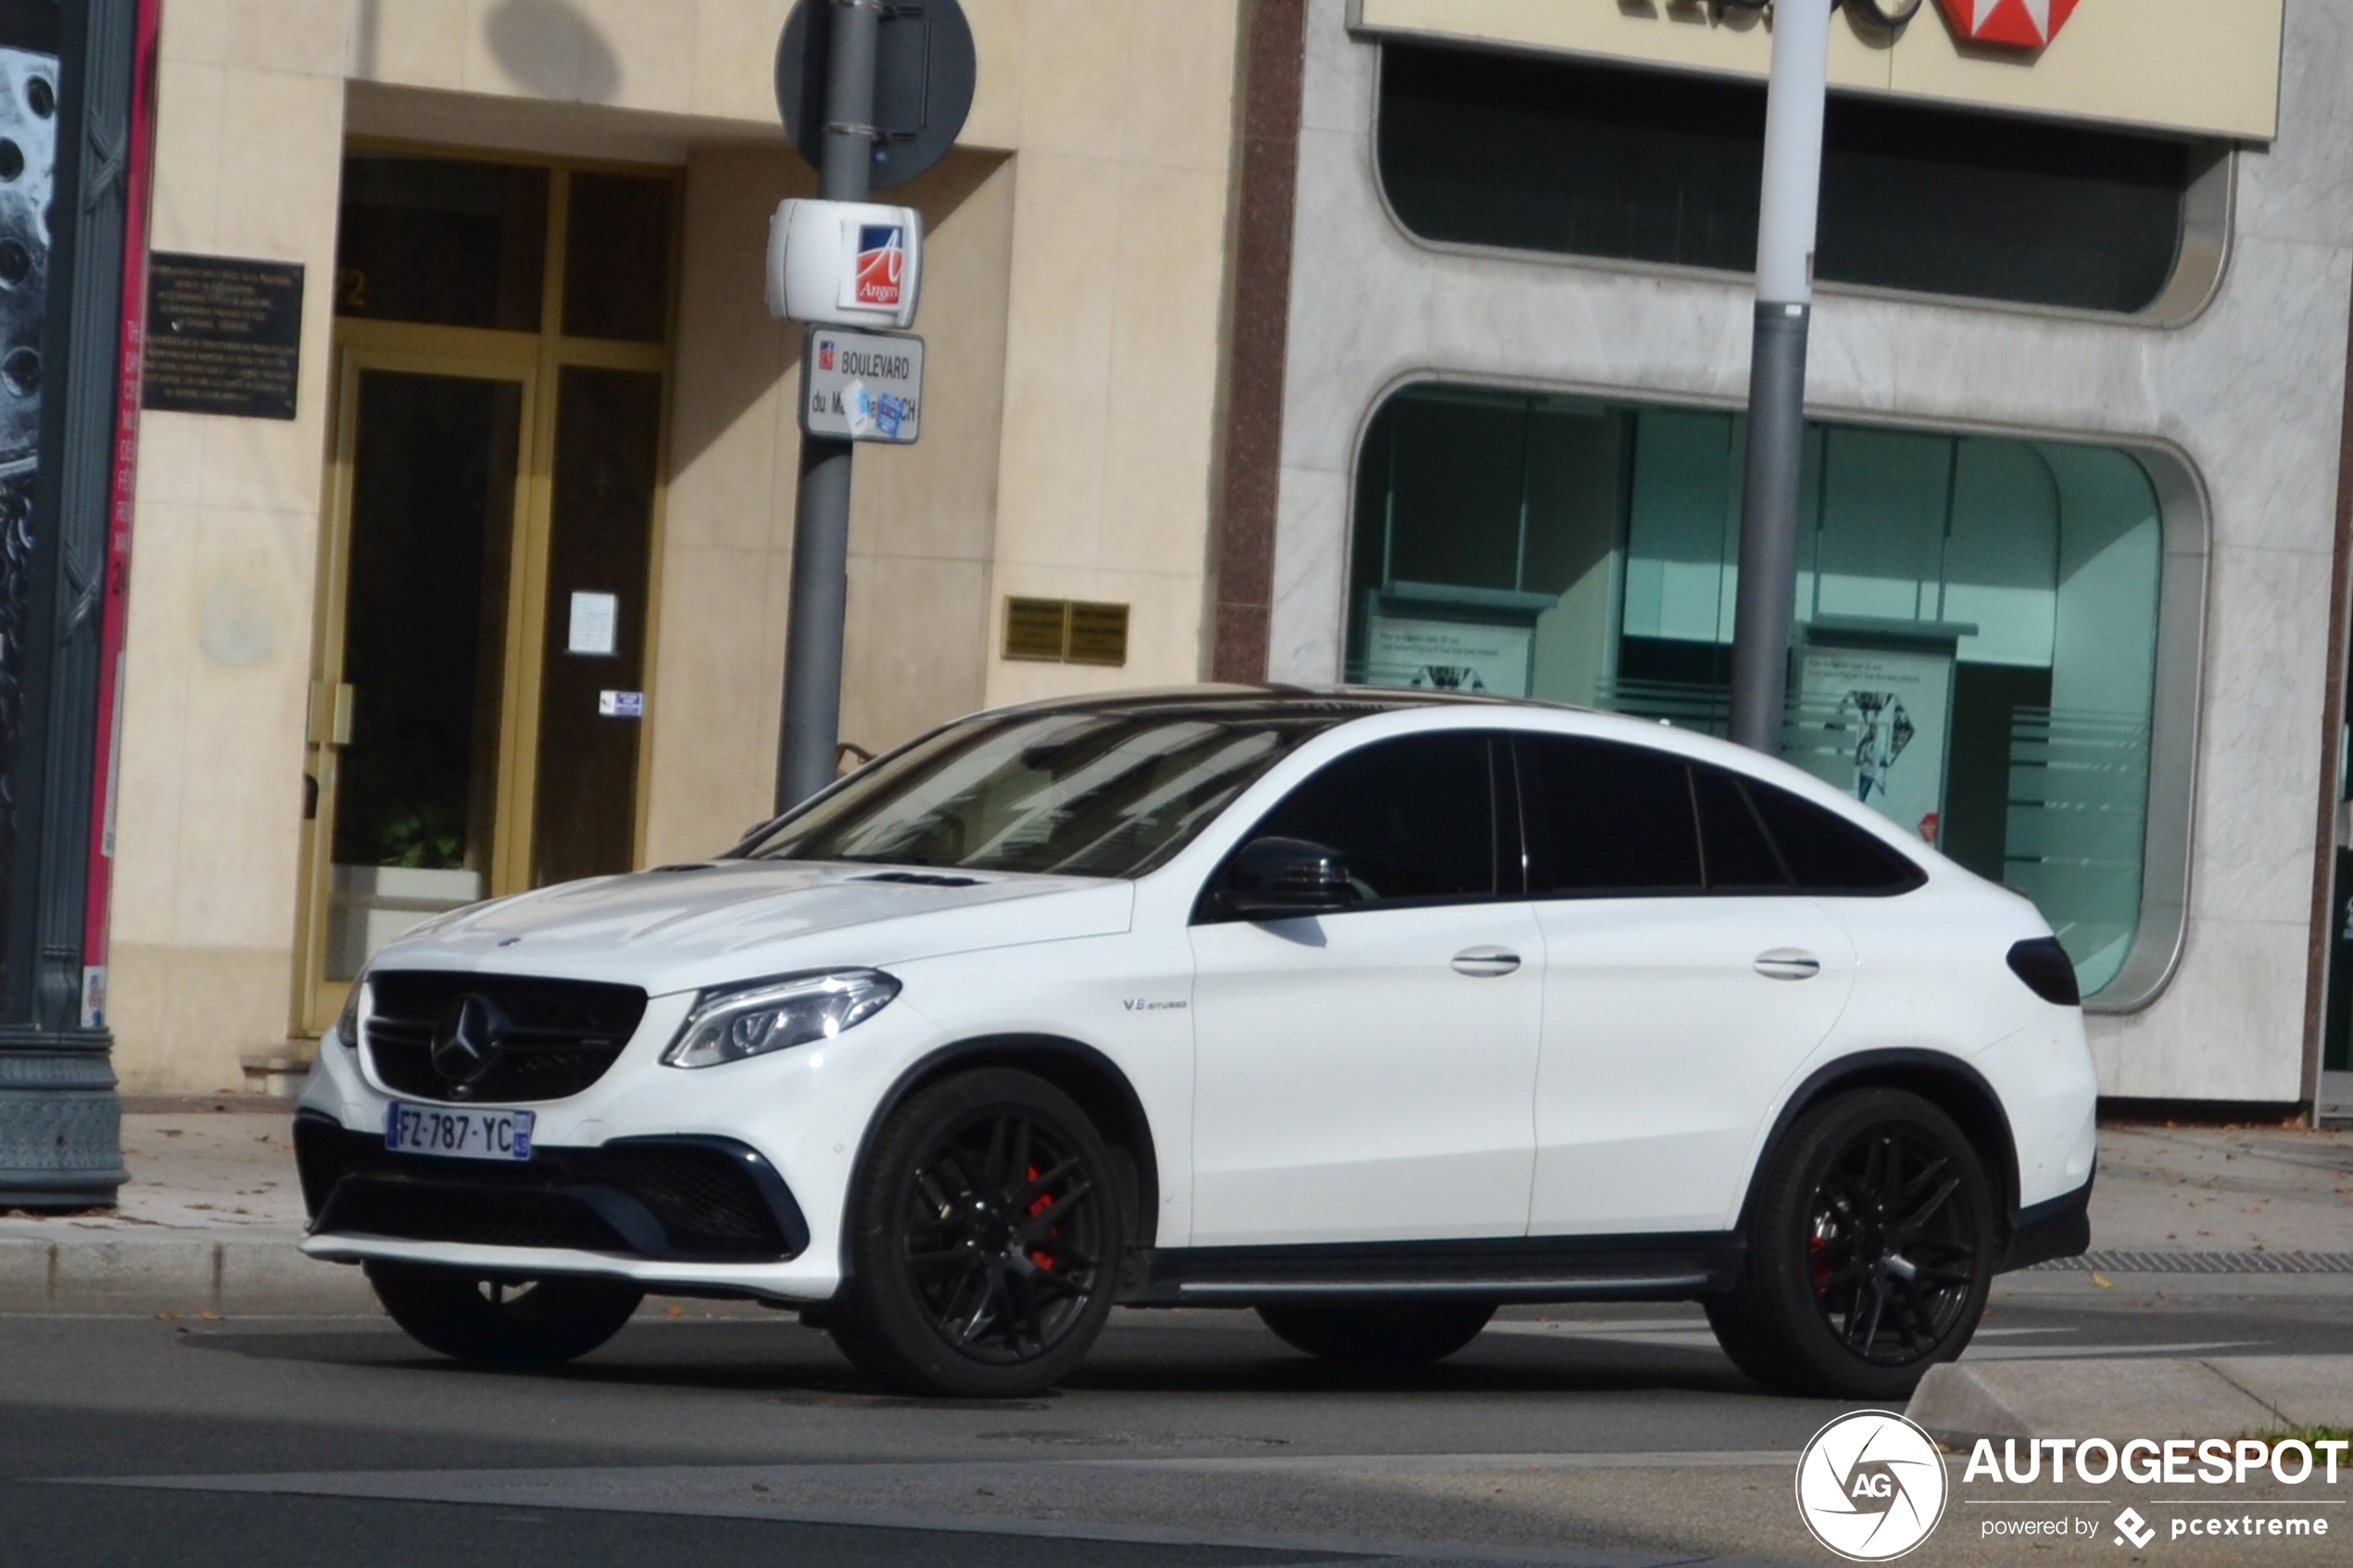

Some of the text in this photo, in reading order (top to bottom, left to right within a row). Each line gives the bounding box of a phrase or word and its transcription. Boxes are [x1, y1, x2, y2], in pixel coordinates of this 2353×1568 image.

[841, 351, 910, 380] BOULEVARD
[812, 390, 825, 412] du
[399, 1110, 512, 1152] FZ-787-YC
